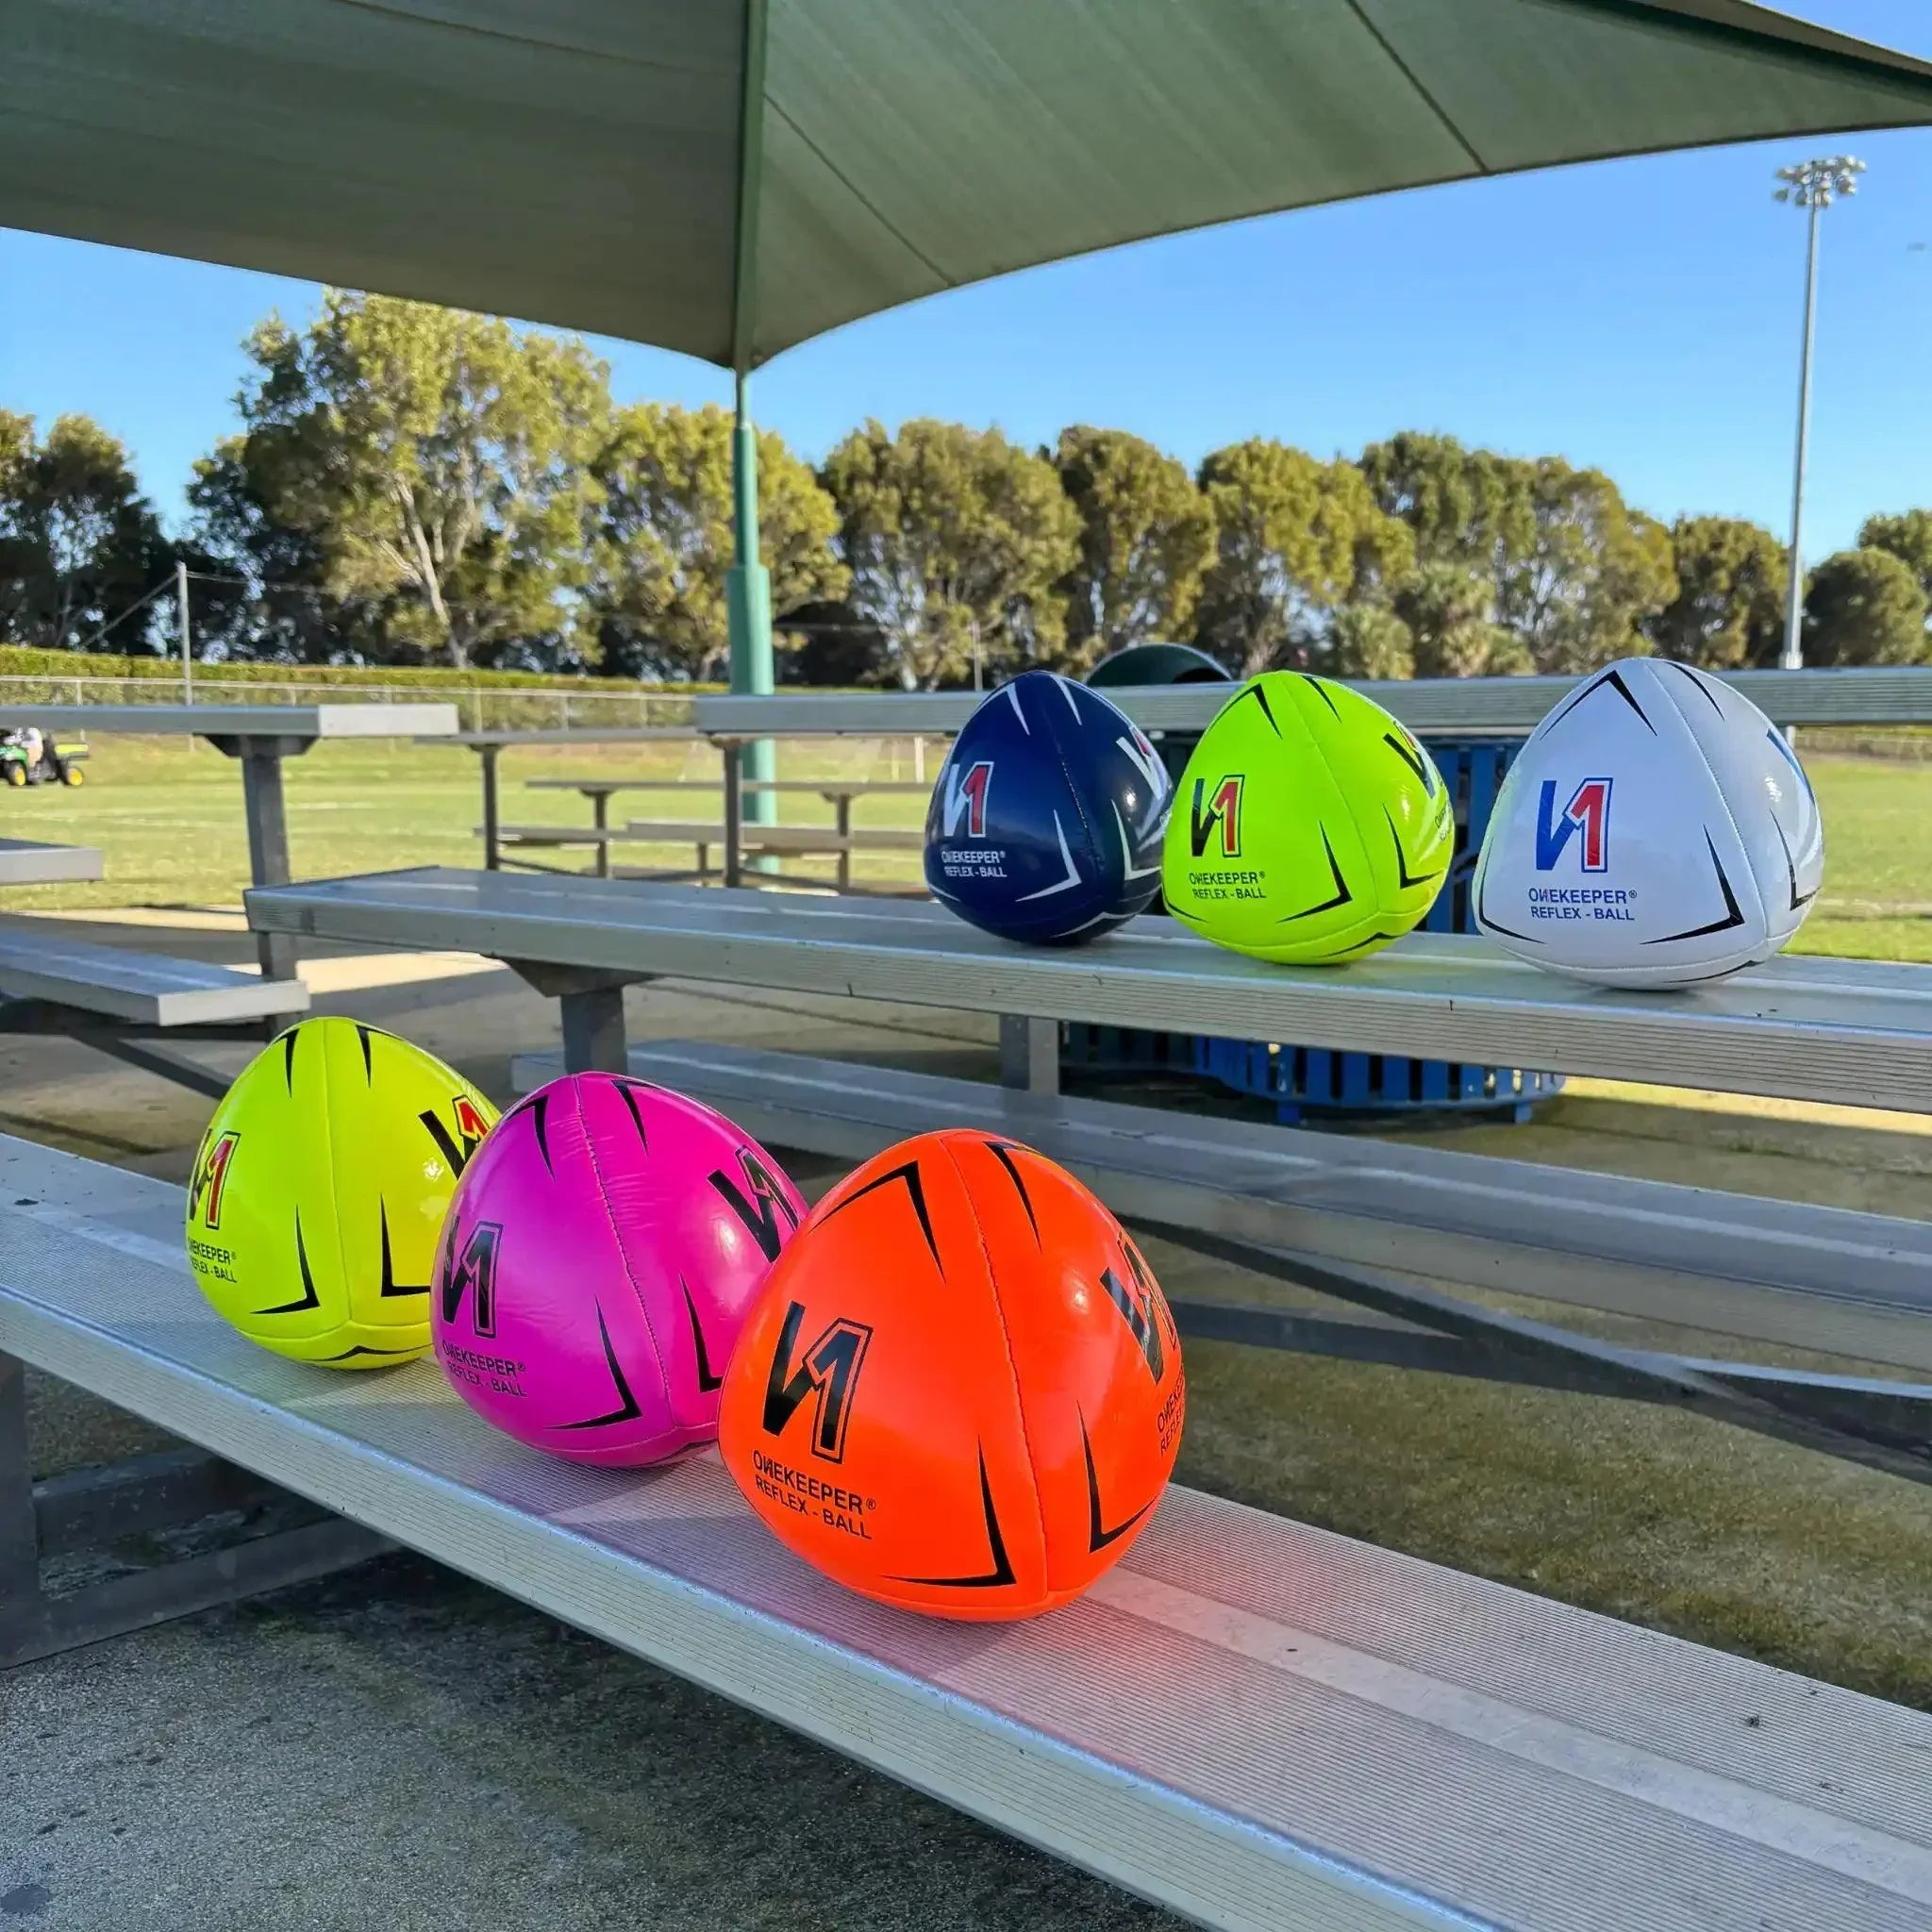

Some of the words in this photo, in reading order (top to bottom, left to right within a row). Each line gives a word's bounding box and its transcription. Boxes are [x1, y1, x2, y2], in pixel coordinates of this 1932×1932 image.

[979, 866, 1008, 877] BALL
[1192, 889, 1228, 899] REFLEX
[1235, 888, 1267, 899] BALL
[1530, 907, 1581, 920] REFLEX
[1593, 908, 1635, 921] BALL
[491, 1377, 528, 1397] BALL
[755, 1474, 808, 1516] REFLEX
[822, 1507, 873, 1541] BALL
